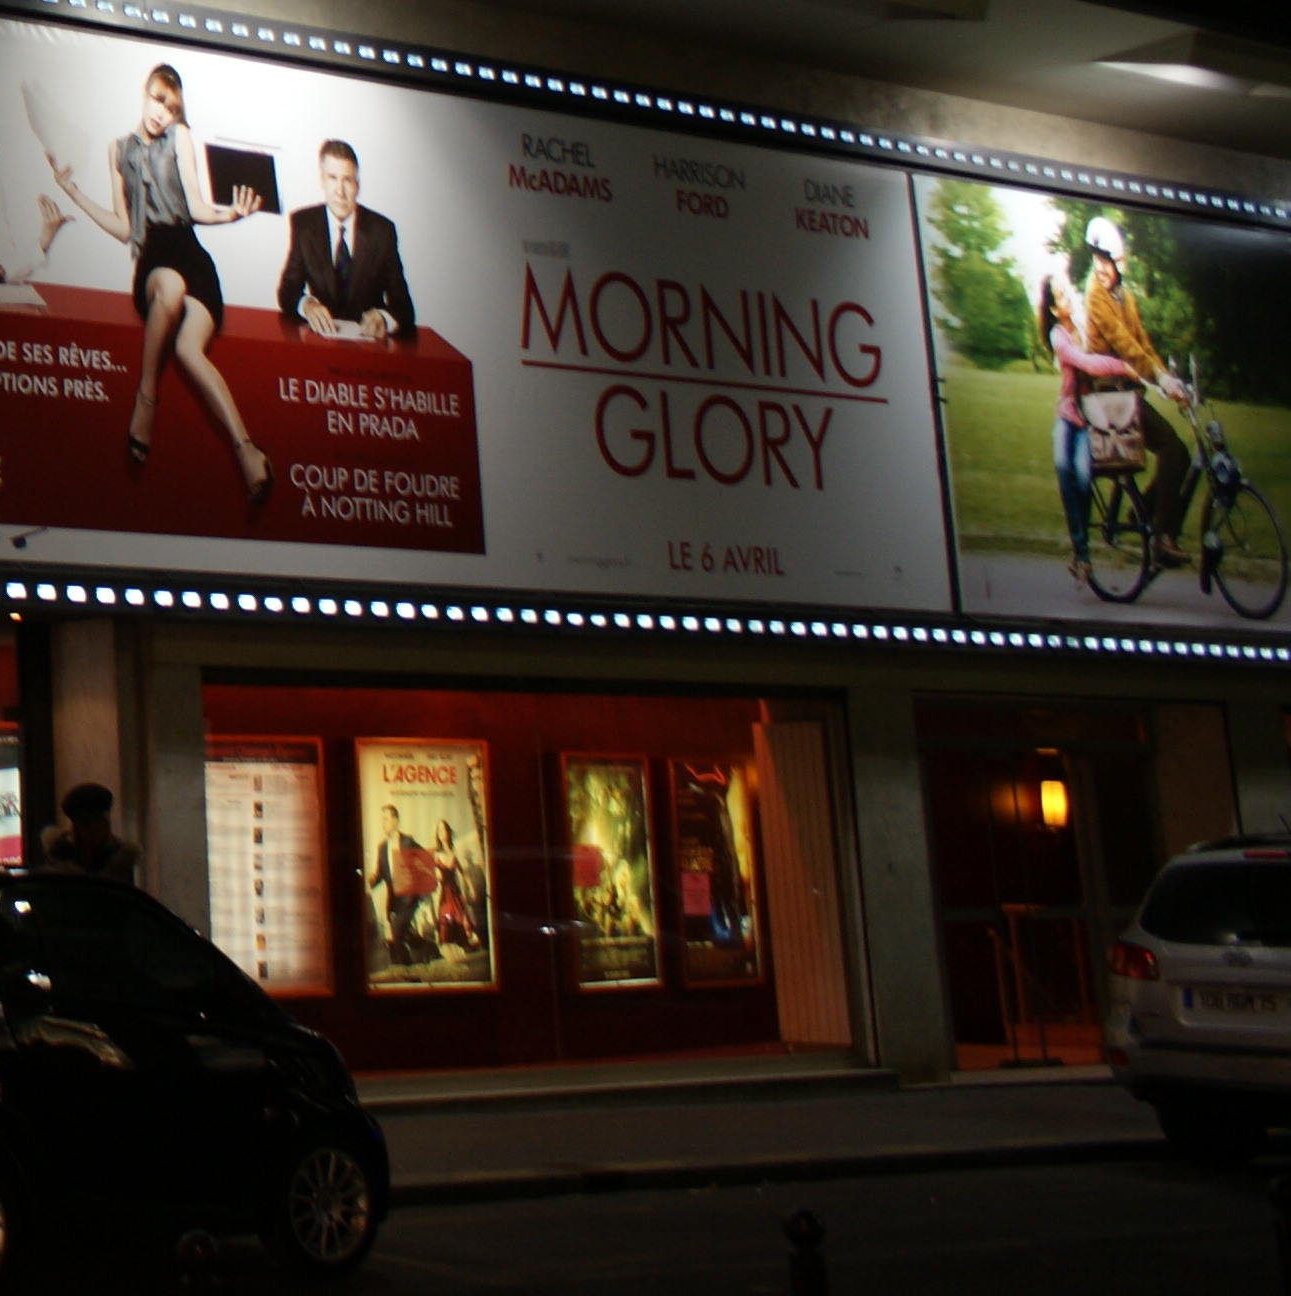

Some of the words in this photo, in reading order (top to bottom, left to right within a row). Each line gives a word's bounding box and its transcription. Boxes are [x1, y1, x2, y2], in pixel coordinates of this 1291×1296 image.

[522, 133, 595, 168] RACHEL
[508, 165, 613, 203] McADAMS
[654, 154, 747, 190] HARRISON
[675, 190, 731, 219] FORD
[804, 178, 855, 208] DIANE
[795, 207, 870, 240] KEATON
[522, 260, 882, 388] MORNING
[23, 342, 53, 365] SES
[64, 375, 110, 402] PRÈS.
[279, 377, 300, 402] LE
[305, 379, 369, 409] DIABLE
[374, 386, 460, 417] S'HABILLE
[326, 410, 354, 435] EN
[359, 413, 420, 442] PRADA
[595, 385, 832, 491] GLORY
[290, 462, 348, 491] COUP
[353, 468, 379, 493] DE
[384, 470, 460, 500] FOUDRE
[302, 488, 318, 518] À
[321, 496, 411, 524] NOTTING
[416, 503, 454, 528] HILL
[667, 540, 692, 571] LE
[700, 543, 714, 573] 6
[723, 545, 785, 576] AVRIL
[383, 764, 457, 785] L'AGENCE
